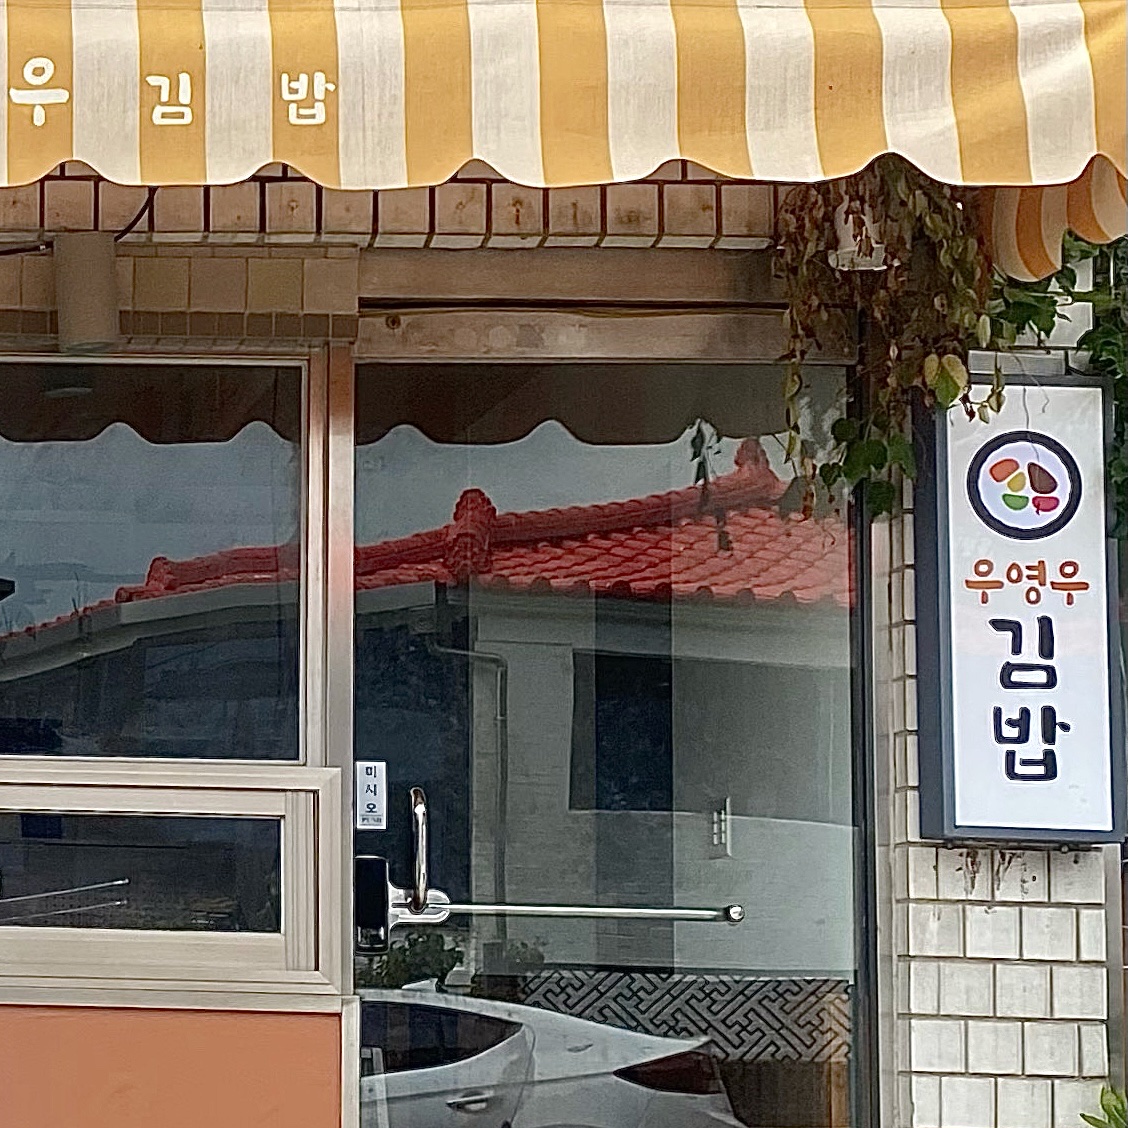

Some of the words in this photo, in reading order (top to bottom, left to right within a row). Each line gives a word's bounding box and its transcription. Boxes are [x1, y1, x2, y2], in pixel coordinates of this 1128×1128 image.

[964, 558, 1090, 606] 우영우
[988, 614, 1072, 782] 김밥
[364, 765, 378, 814] 미시오
